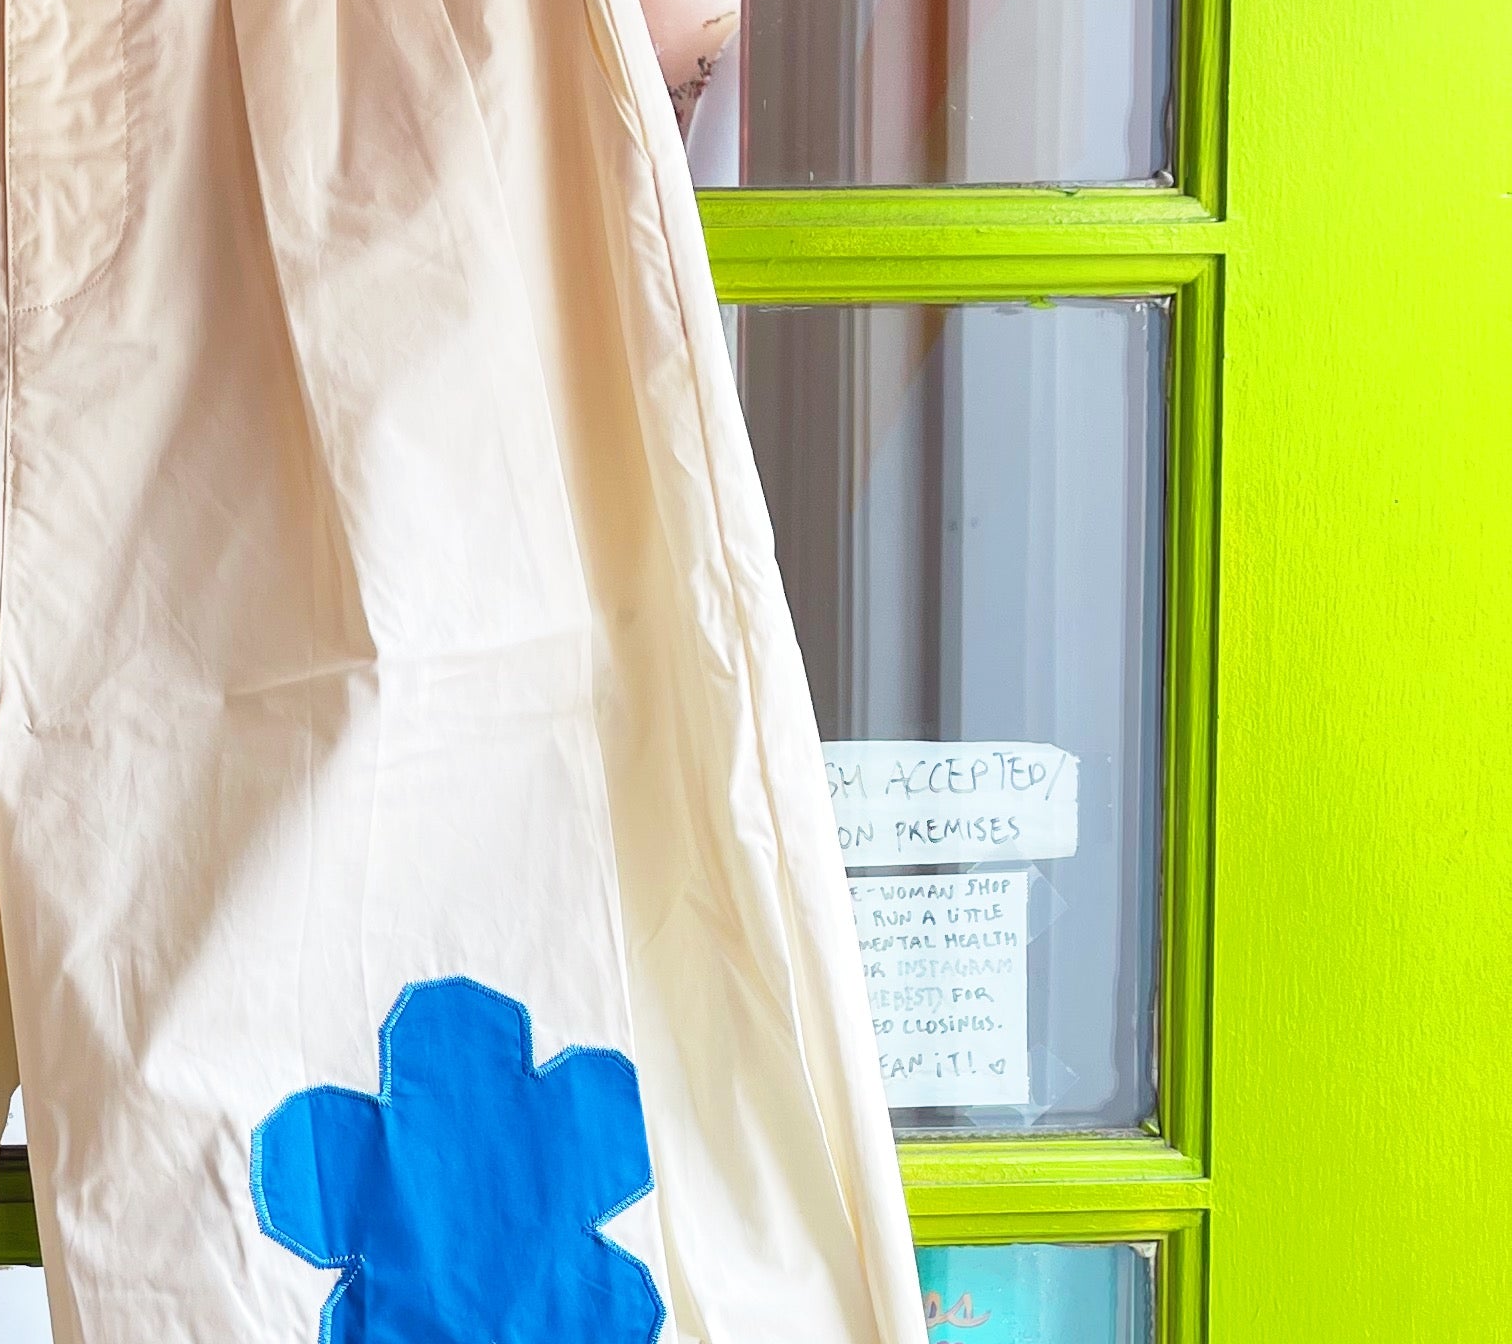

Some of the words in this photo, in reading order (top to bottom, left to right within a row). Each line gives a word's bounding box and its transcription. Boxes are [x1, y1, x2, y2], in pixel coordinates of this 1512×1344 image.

[838, 821, 874, 849] ON
[895, 816, 1021, 853] PREMISES
[965, 878, 1011, 896] SHOP
[872, 910, 913, 927] RUN
[922, 910, 937, 926] A
[944, 931, 1018, 949] HEALTH
[897, 958, 1014, 978] INSTAGRAM
[952, 986, 995, 1002] FOR
